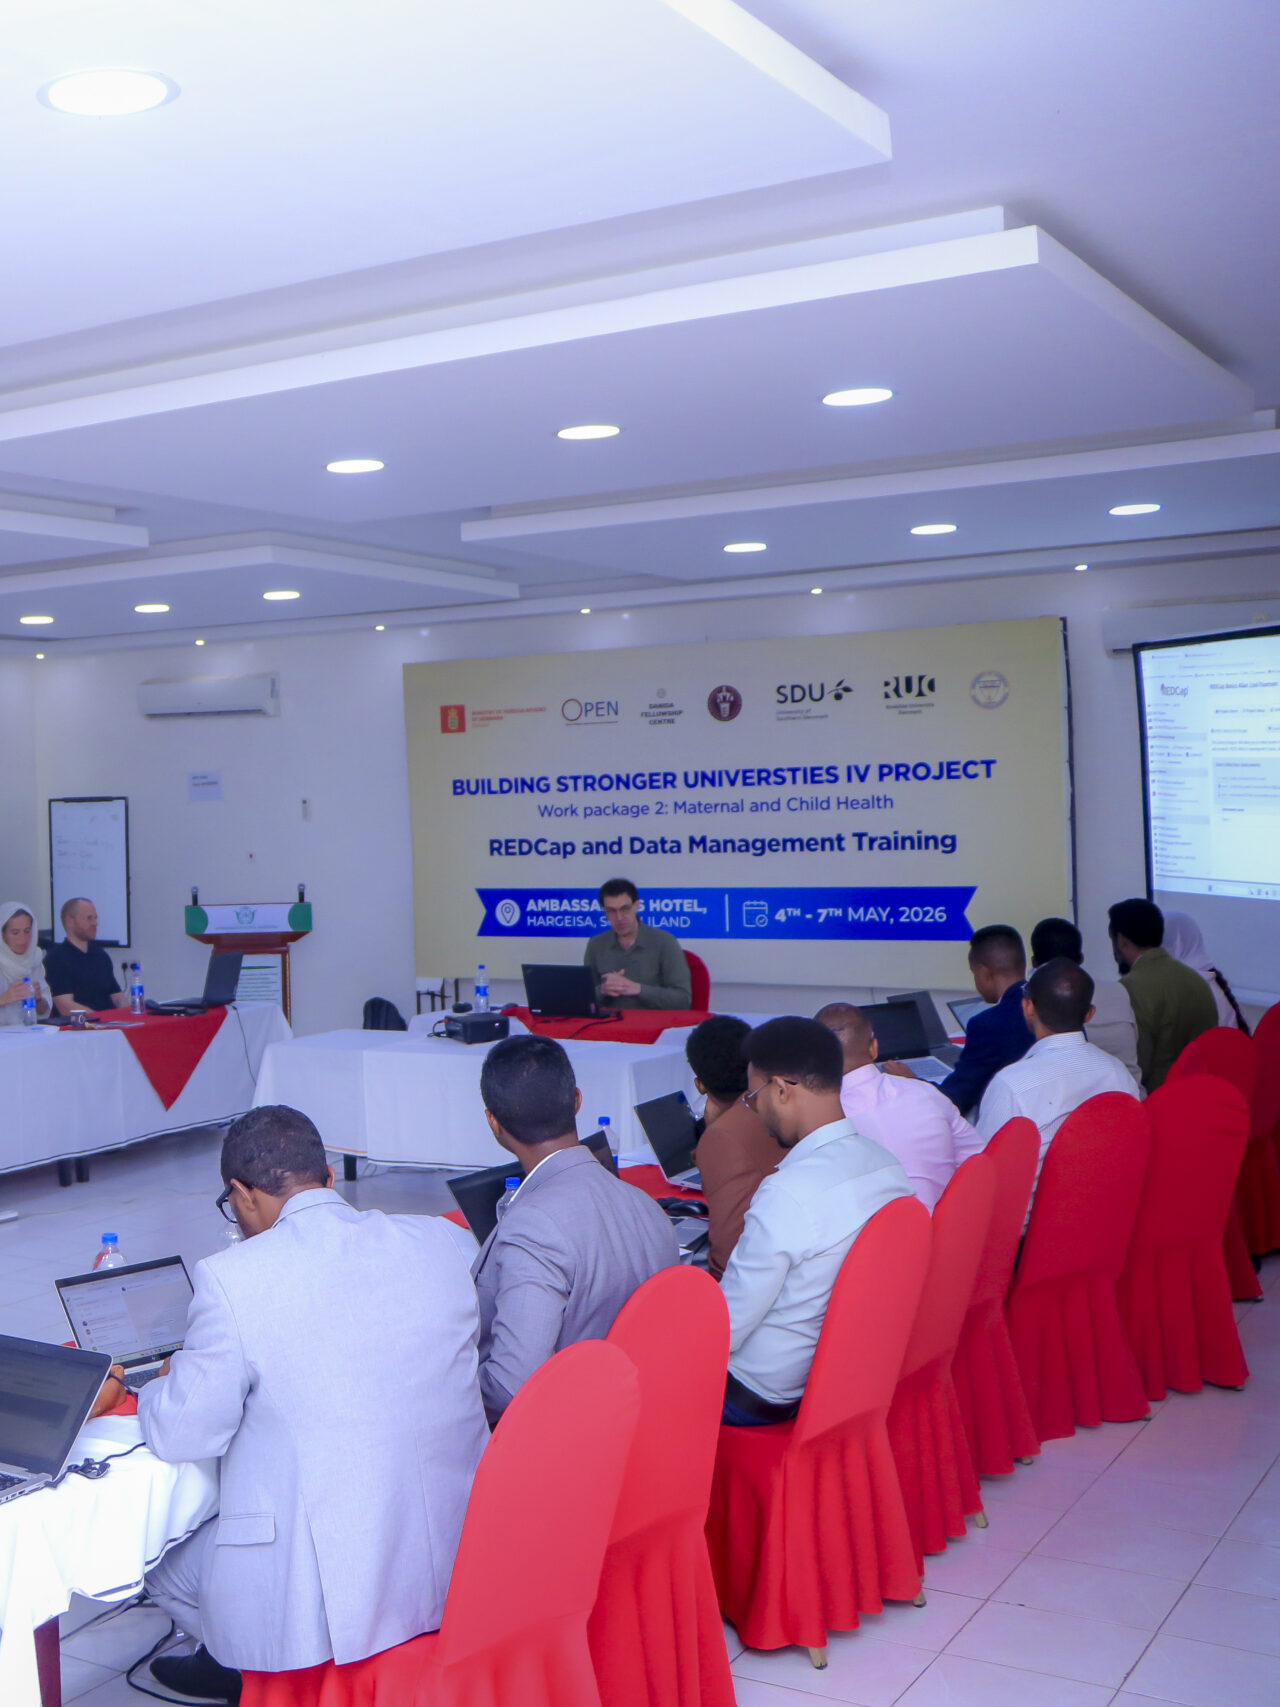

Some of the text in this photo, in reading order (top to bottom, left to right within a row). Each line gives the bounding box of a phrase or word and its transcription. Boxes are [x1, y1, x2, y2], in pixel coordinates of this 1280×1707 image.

[776, 683, 825, 704] SDU
[561, 698, 619, 722] OPEN
[452, 759, 997, 796] BUILDING STRONGER UNIVERSTIES IV PROJECT
[538, 794, 894, 819] Work package 2: Maternal and Child Health
[489, 830, 958, 859] REDCap and Data Management Training
[526, 899, 707, 914] AMBASSAS HOTEL,
[775, 908, 801, 922] 4TH
[818, 908, 842, 922] 7TH
[848, 907, 894, 924] MAY,
[899, 907, 947, 922] 2026
[526, 916, 597, 929] HARGEISA,
